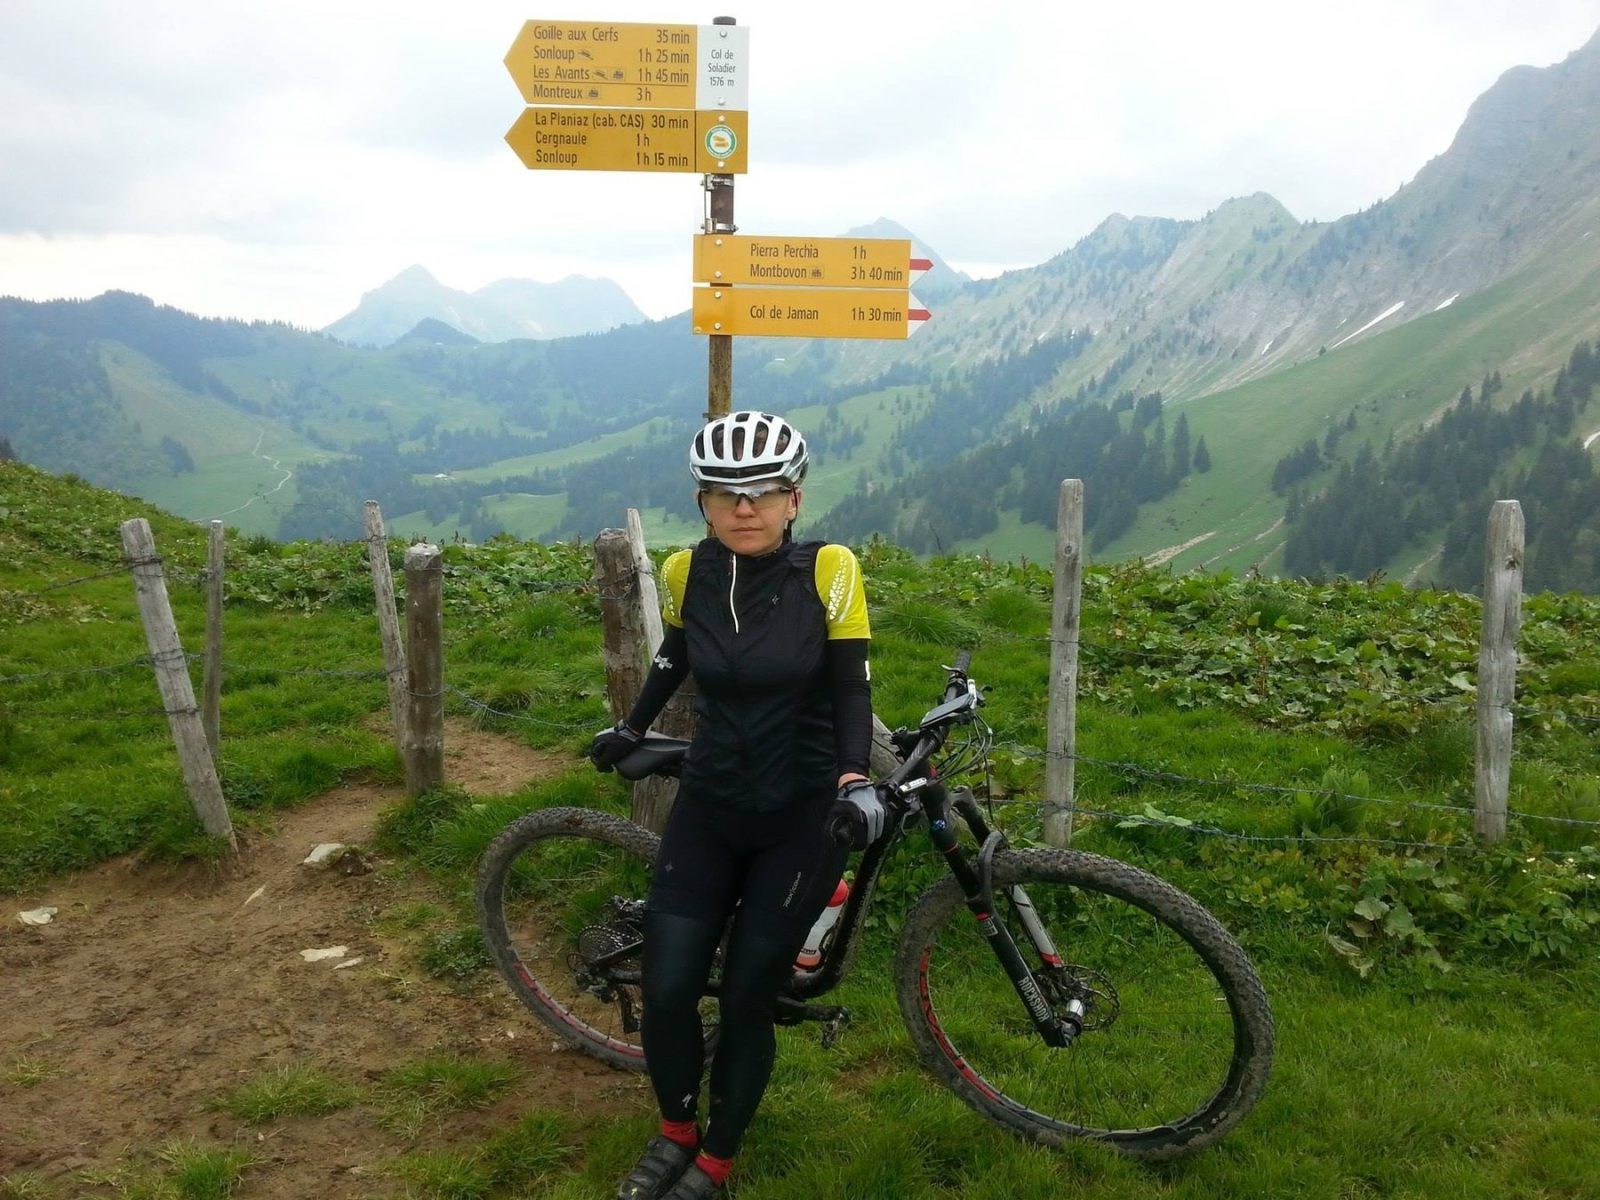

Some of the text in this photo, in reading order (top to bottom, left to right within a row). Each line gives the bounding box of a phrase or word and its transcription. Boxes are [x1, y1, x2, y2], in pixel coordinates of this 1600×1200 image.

[533, 25, 690, 44] Goille aux Cerfs 35 min
[533, 45, 689, 63] Sonloup 1 h 25 min
[711, 49, 734, 60] Col de
[533, 64, 689, 83] Les Avants 1 h 45 min
[707, 62, 736, 73] Soladier
[710, 76, 735, 87] 1576 m
[533, 84, 652, 101] Montreux 3 h
[535, 112, 689, 131] La Planiaz (cab. CAS) 30 min
[535, 130, 650, 148] Cergnaule 1 h
[535, 149, 689, 167] Sonloup 1 h 15 min
[750, 243, 867, 260] Pierra Perchia 1 h
[750, 263, 903, 281] Montbovon 3 h 40 min
[750, 305, 902, 322] Col de Jaman 1 h 30 min
[1017, 975, 1050, 1024] ROCKSHOX
